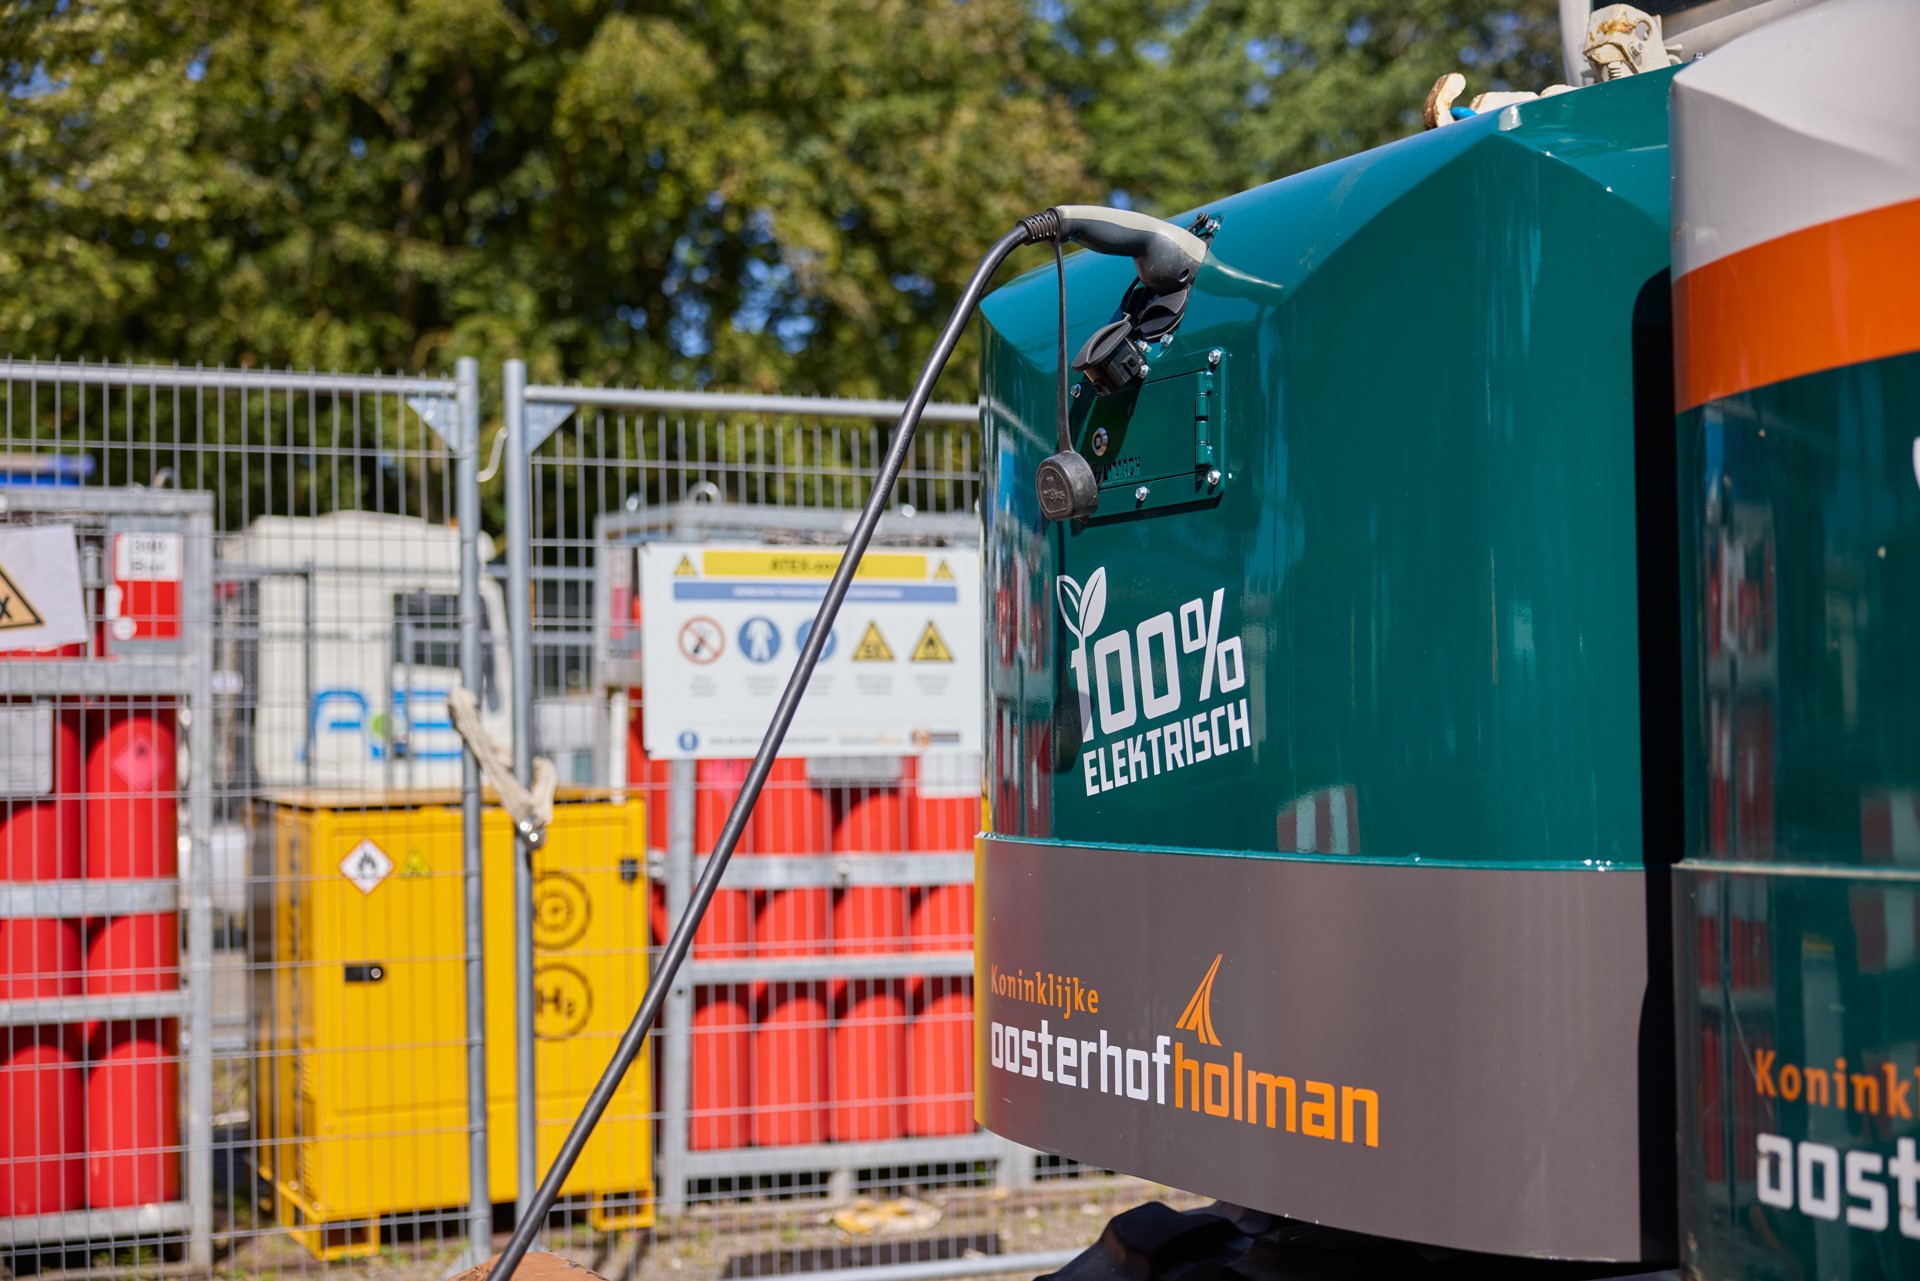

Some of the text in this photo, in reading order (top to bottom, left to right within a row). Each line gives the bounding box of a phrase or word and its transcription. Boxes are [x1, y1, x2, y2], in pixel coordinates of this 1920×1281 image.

[1070, 587, 1246, 744] 100%
[1082, 698, 1251, 797] ELEKTRISCH
[990, 963, 1100, 1020] Koninklijke
